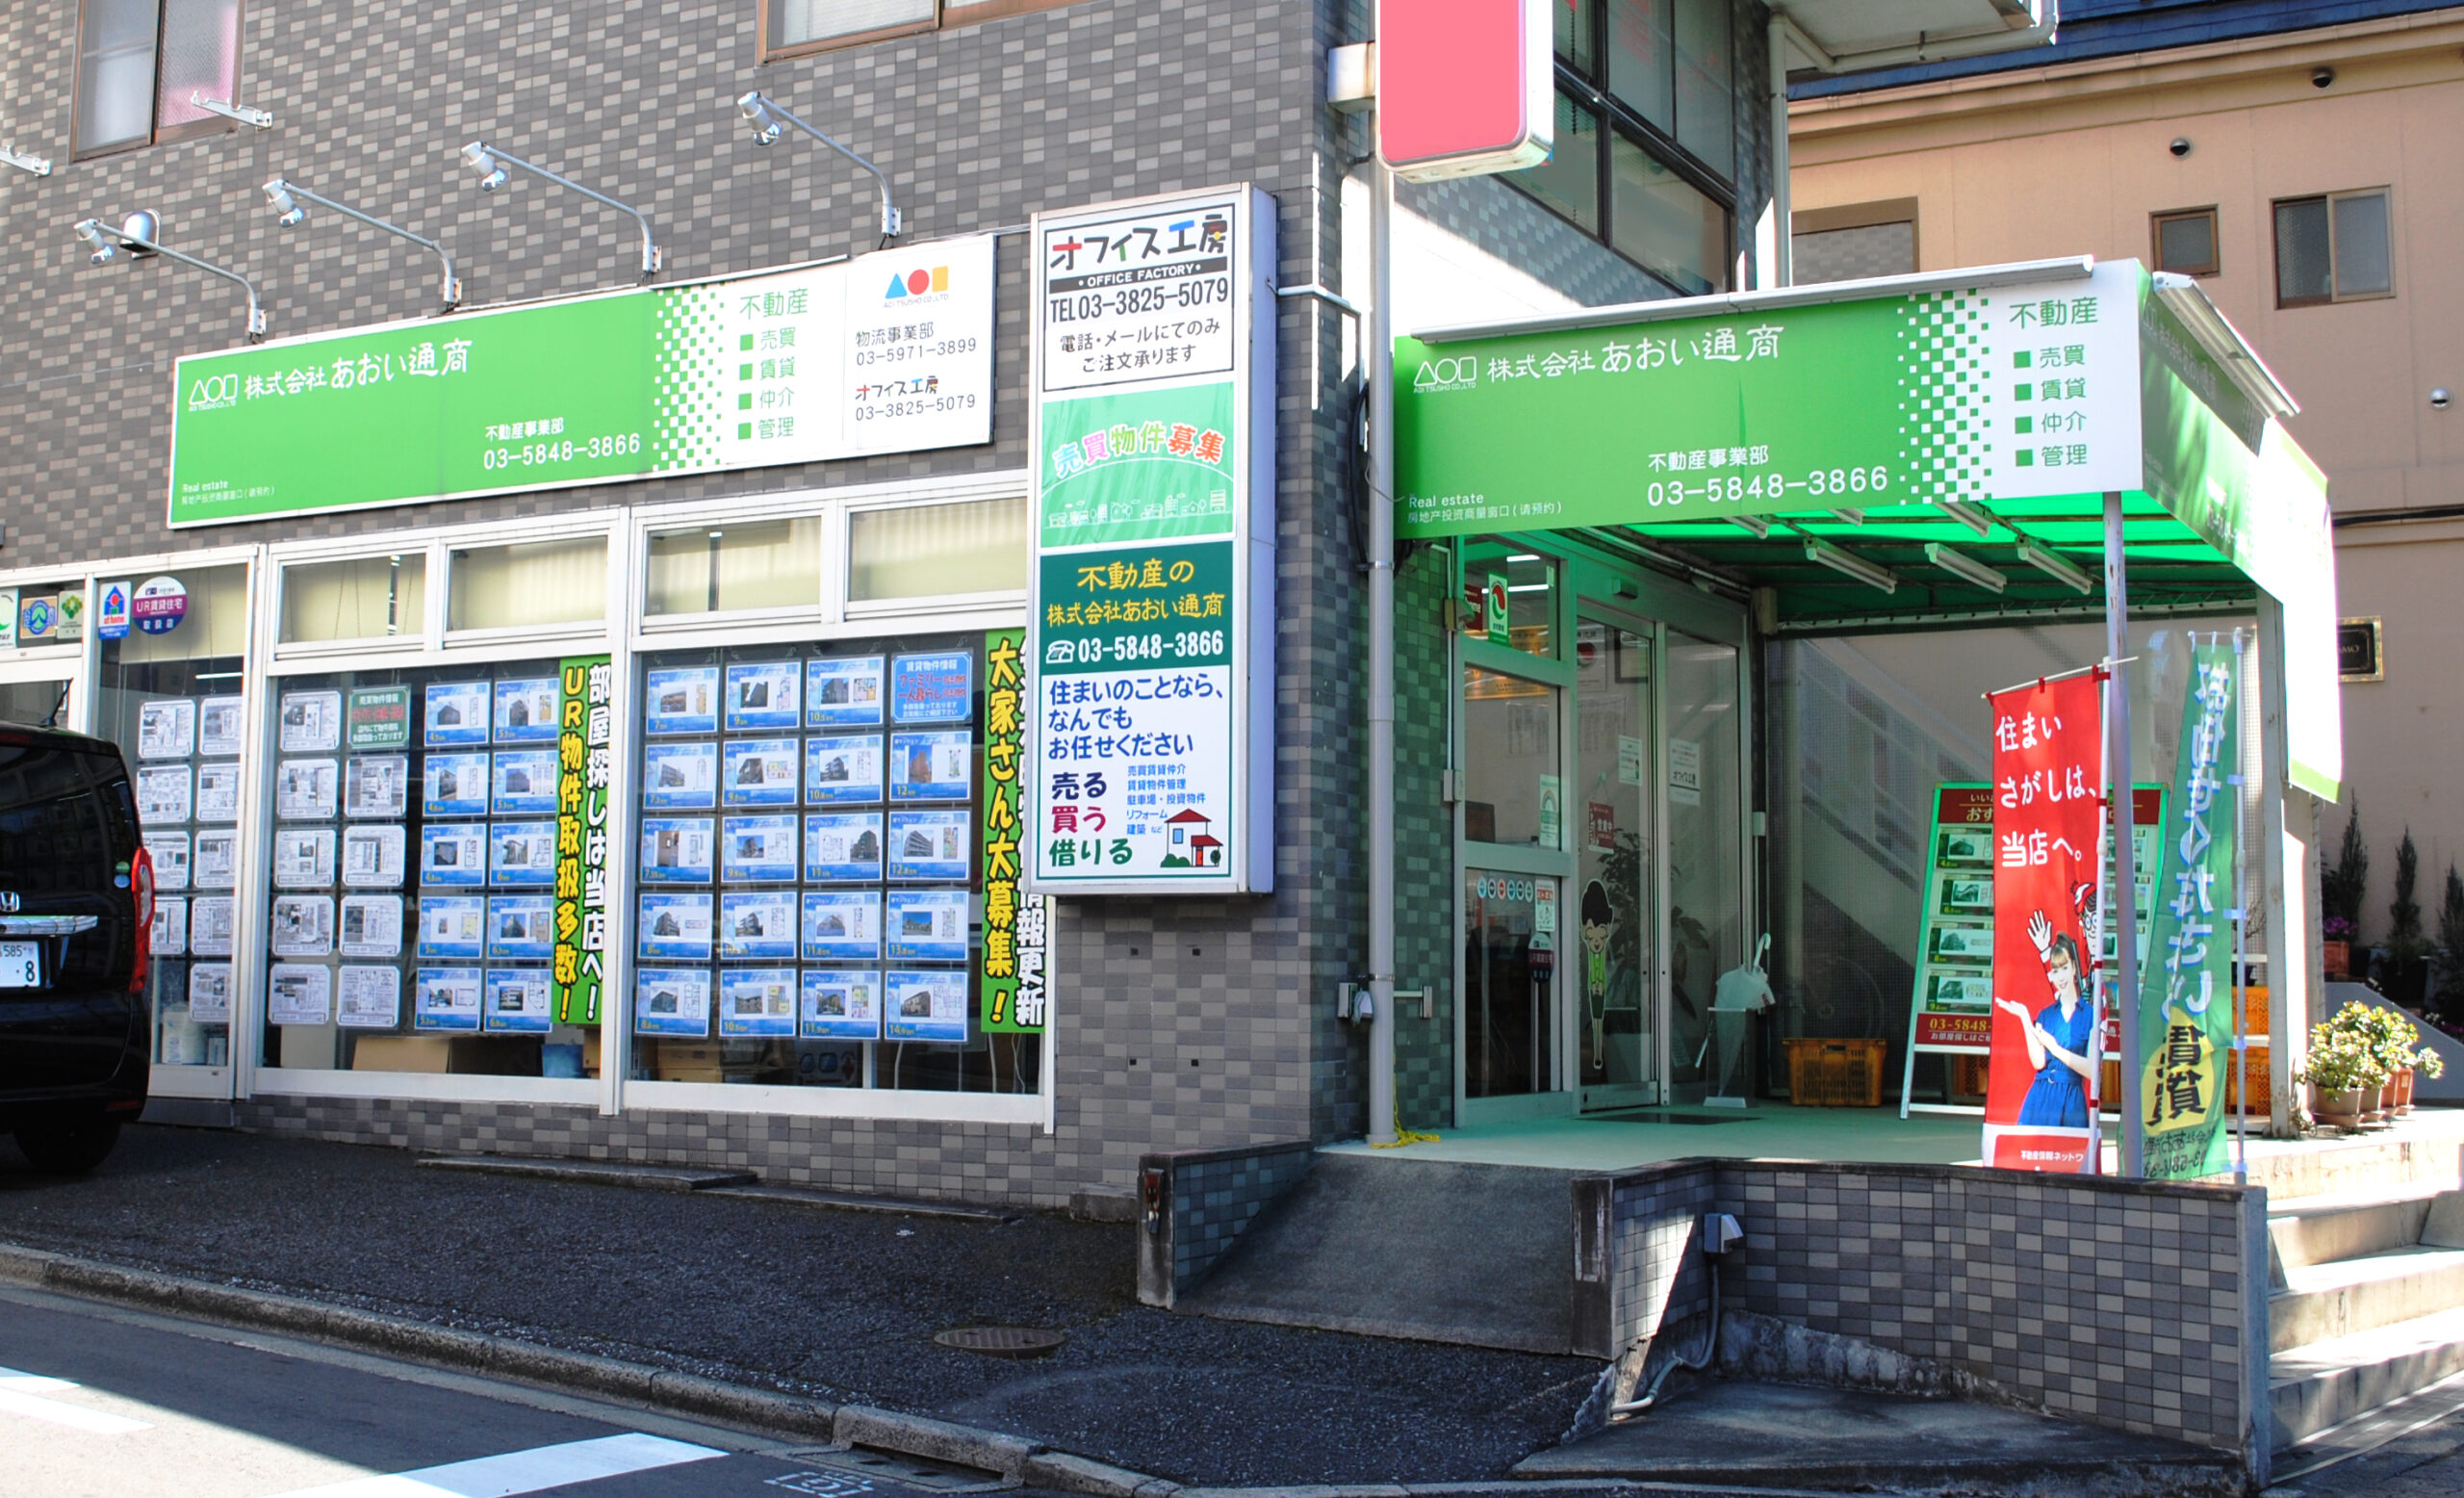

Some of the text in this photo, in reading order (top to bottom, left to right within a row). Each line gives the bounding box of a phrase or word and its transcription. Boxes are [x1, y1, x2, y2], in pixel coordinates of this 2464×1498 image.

[1050, 214, 1227, 271] オフィス工房
[1088, 263, 1194, 287] OFFICE FACTORY
[739, 288, 809, 321] 不動産
[2009, 297, 2098, 329] 不動産
[760, 327, 796, 350] 売買
[856, 321, 934, 348] 物流事業部
[1061, 318, 1220, 352] 電話・メールにてのみ
[857, 337, 977, 367] 03-5971-3899
[1083, 344, 1196, 373] ご注文承ります
[1487, 323, 1784, 383] 株式会社あおい通商
[2040, 344, 2086, 370] 売買
[244, 337, 473, 401] 株式会社あおい通商
[759, 356, 796, 380] 賃貸
[759, 386, 795, 411] 仲介
[856, 375, 938, 401] オフィス工房
[2040, 376, 2087, 401] 賃貸
[856, 394, 976, 421] 03-3825-5079
[484, 417, 564, 443] 不動産事業部
[757, 416, 795, 439] 管理
[2040, 411, 2087, 434] 仲介
[483, 432, 642, 472] 03-5848-3866
[1053, 421, 1225, 478] 売買物件募集
[1648, 445, 1769, 472] 不動産事業部
[2040, 444, 2088, 468] 管理
[1409, 492, 1484, 508] Real estate
[1647, 465, 1889, 506] 03-5848-3866
[1077, 558, 1194, 592] 不動産の
[1047, 592, 1225, 628] 株式会社あおい通商
[1078, 631, 1223, 663] 03-5848-3866
[1049, 673, 1223, 706] 住まいのことなら、
[1049, 706, 1133, 732] なんでも
[1995, 711, 2062, 752] 住まい
[1049, 733, 1194, 761] お任せください
[1051, 772, 1107, 800] 売る
[2000, 764, 2097, 809] さがしは、
[1052, 805, 1106, 834] 買う
[1126, 809, 1168, 820] リフォーム
[1049, 838, 1133, 867] 借りる
[2001, 828, 2082, 867] 当店へ。
